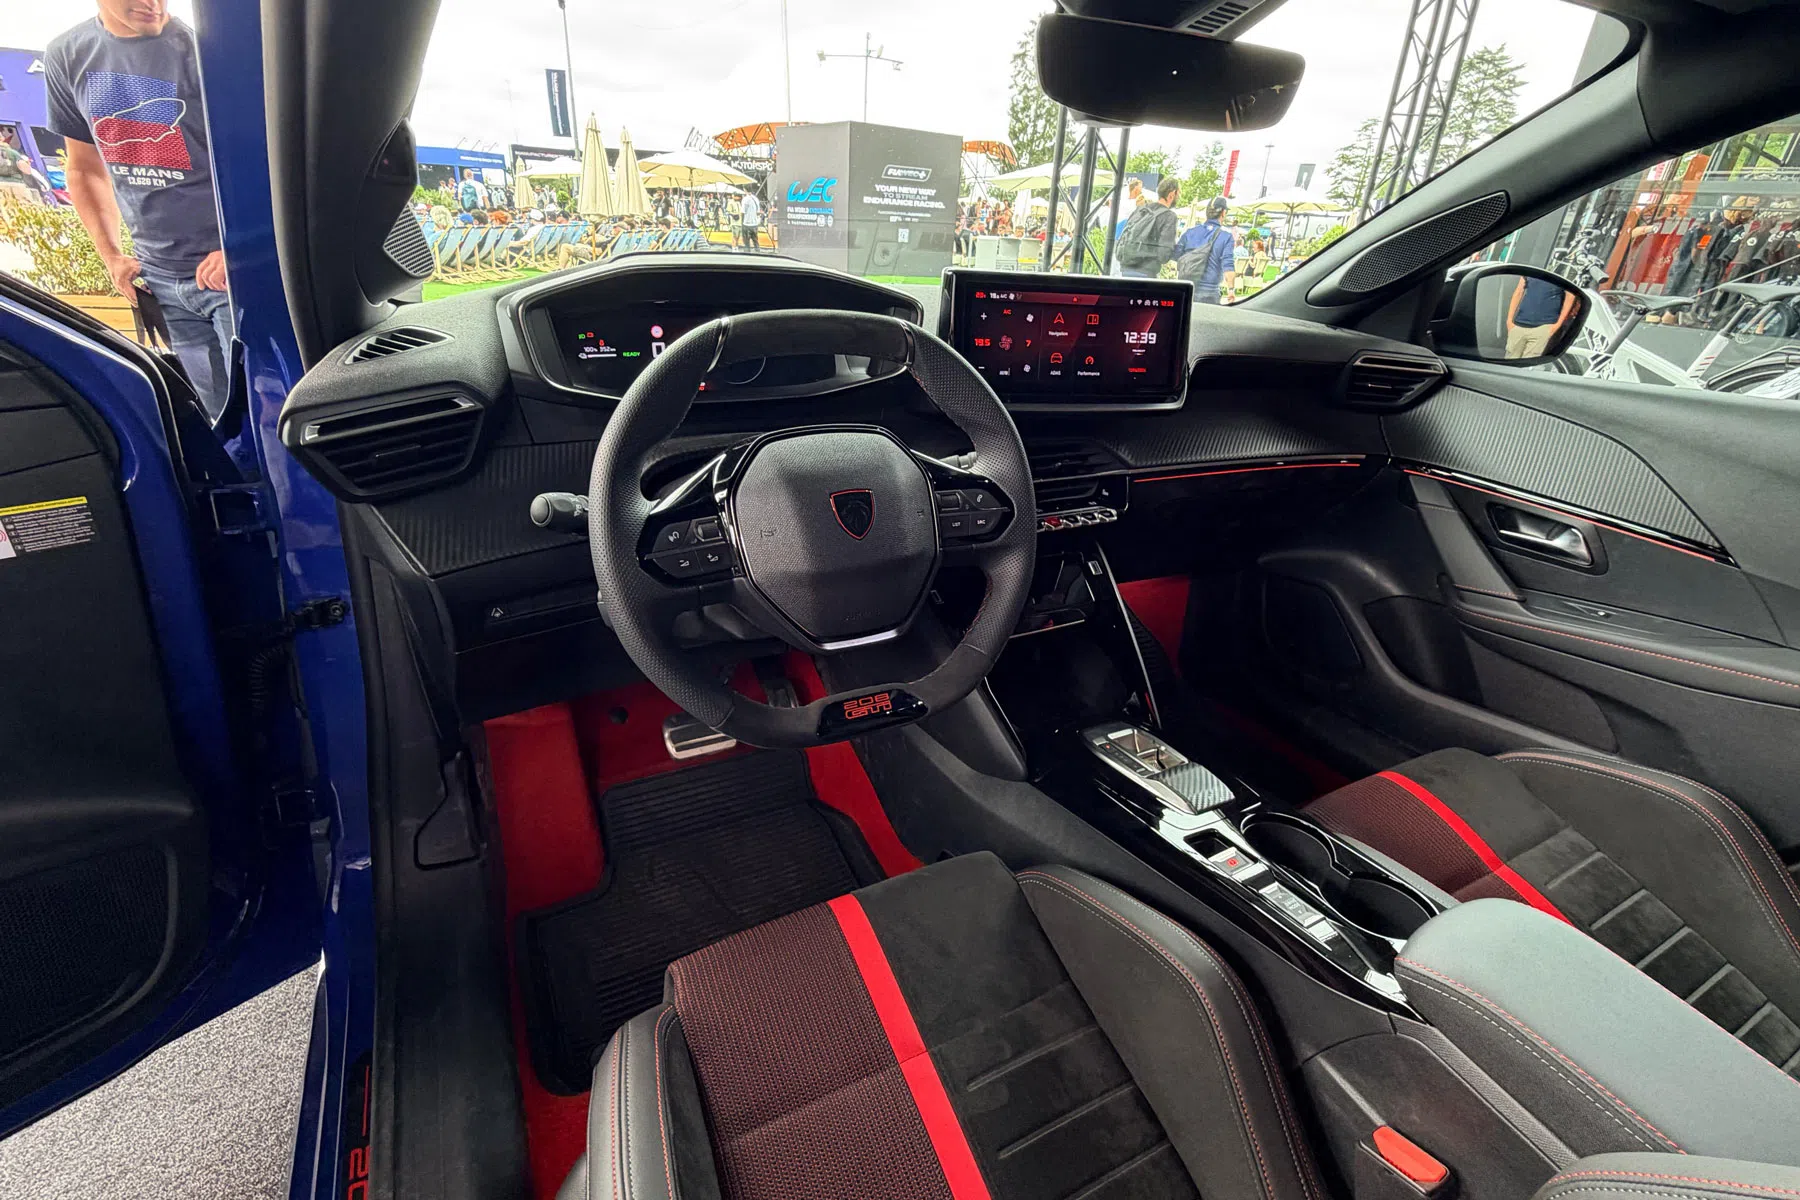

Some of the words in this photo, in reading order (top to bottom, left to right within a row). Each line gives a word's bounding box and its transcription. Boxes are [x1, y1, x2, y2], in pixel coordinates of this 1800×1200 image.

[111, 165, 130, 175] LE
[132, 167, 185, 180] MANS
[152, 178, 167, 188] KM
[786, 176, 838, 203] WEC
[874, 184, 898, 194] YOUR
[898, 186, 918, 195] NEW
[918, 188, 937, 197] WAY
[863, 196, 914, 207] ENDURANCE
[1025, 339, 1032, 347] 7
[1124, 331, 1157, 344] 12:39
[843, 693, 889, 709] 208
